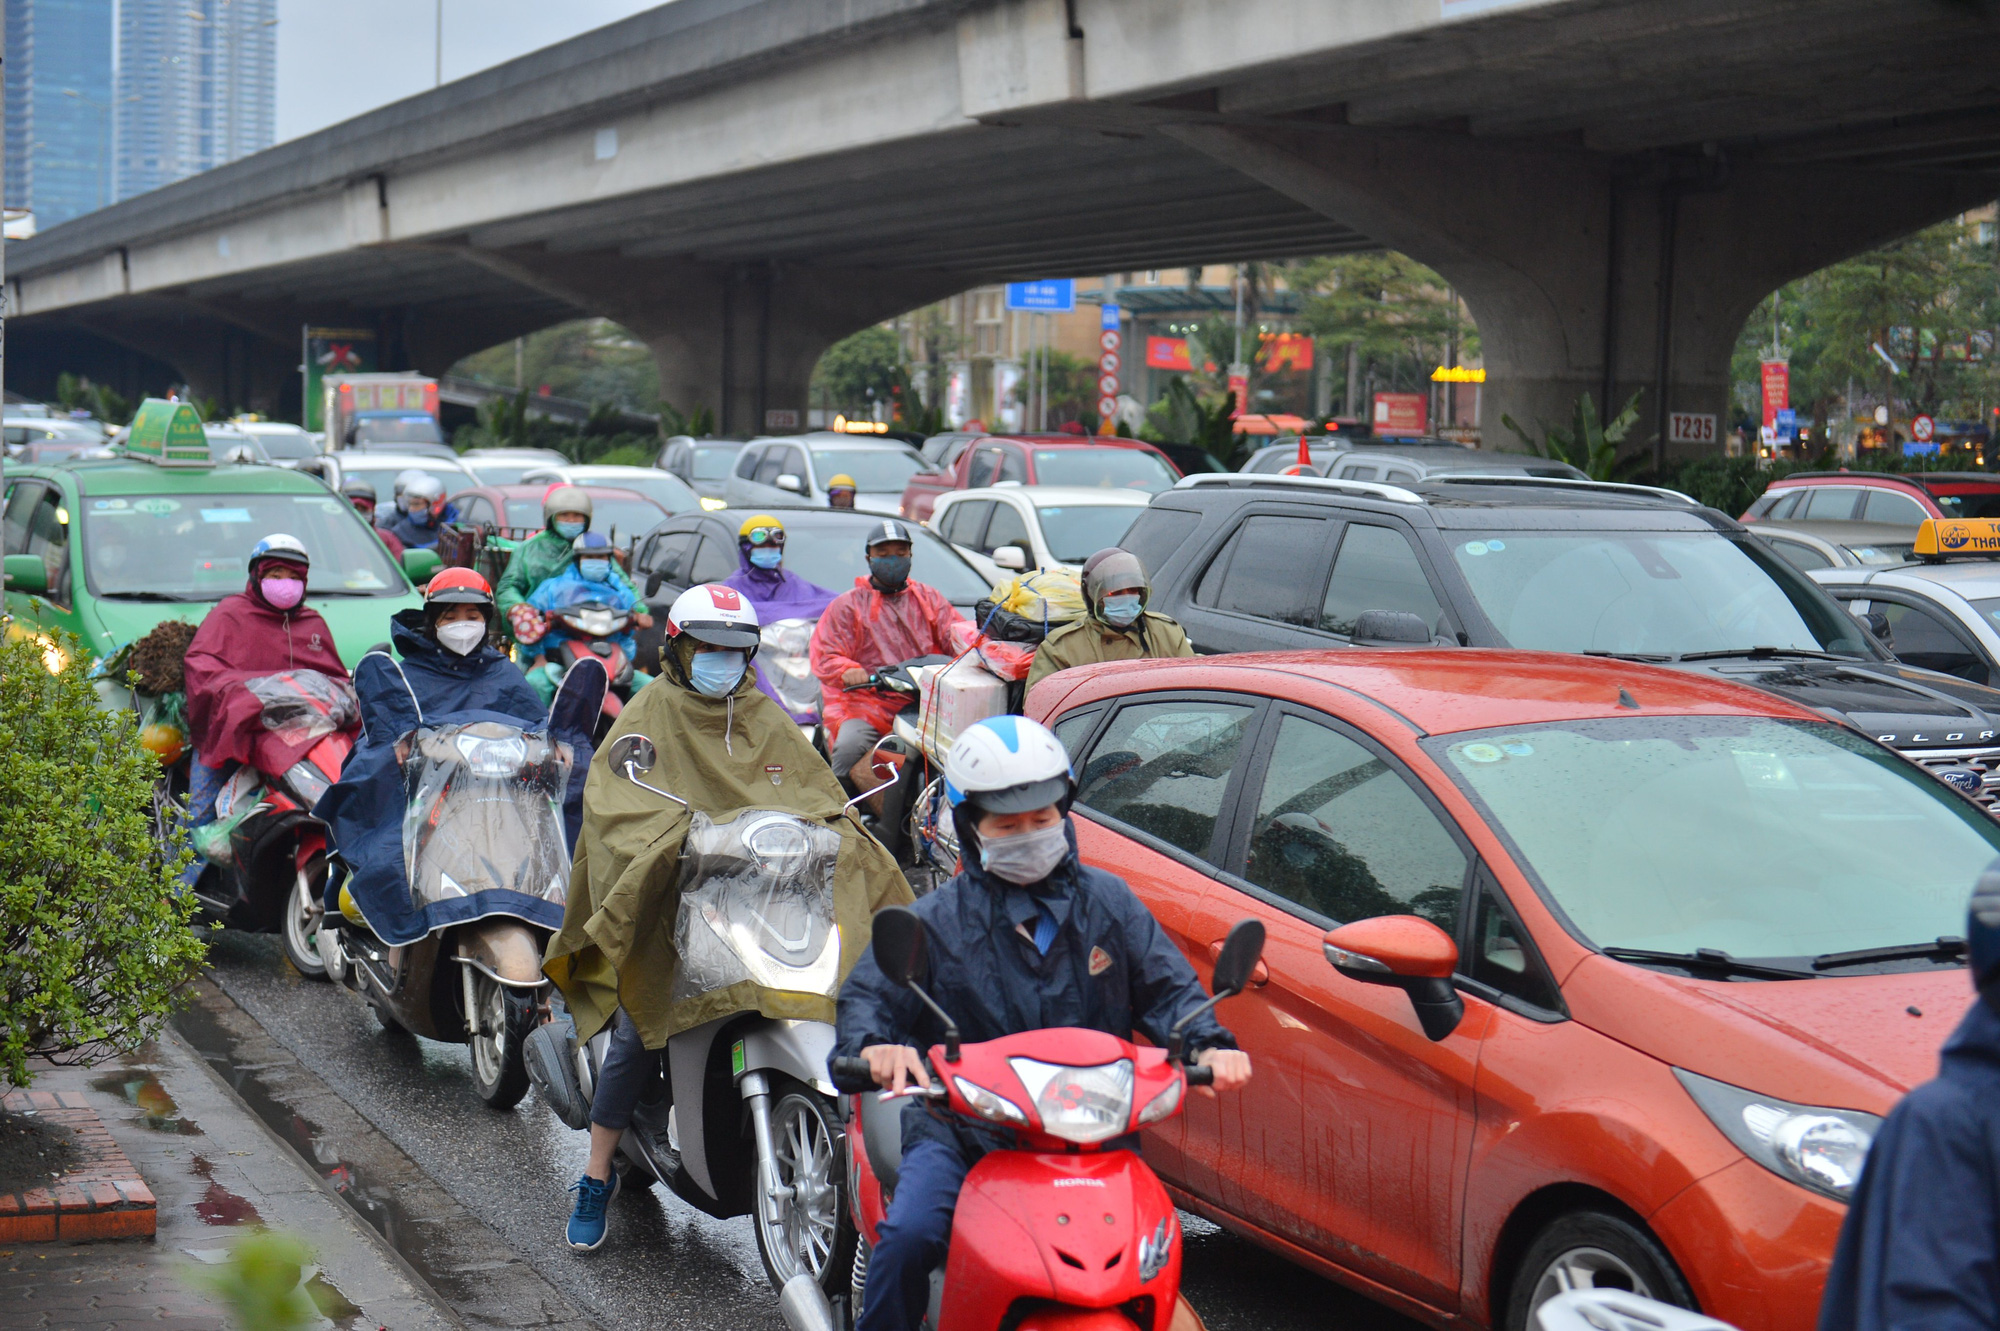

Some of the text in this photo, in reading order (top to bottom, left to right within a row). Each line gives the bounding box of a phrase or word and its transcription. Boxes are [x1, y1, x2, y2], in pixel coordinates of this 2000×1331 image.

[172, 423, 201, 435] TAXI
[1673, 416, 1713, 440] T235
[1053, 1177, 1106, 1188] HONDA
